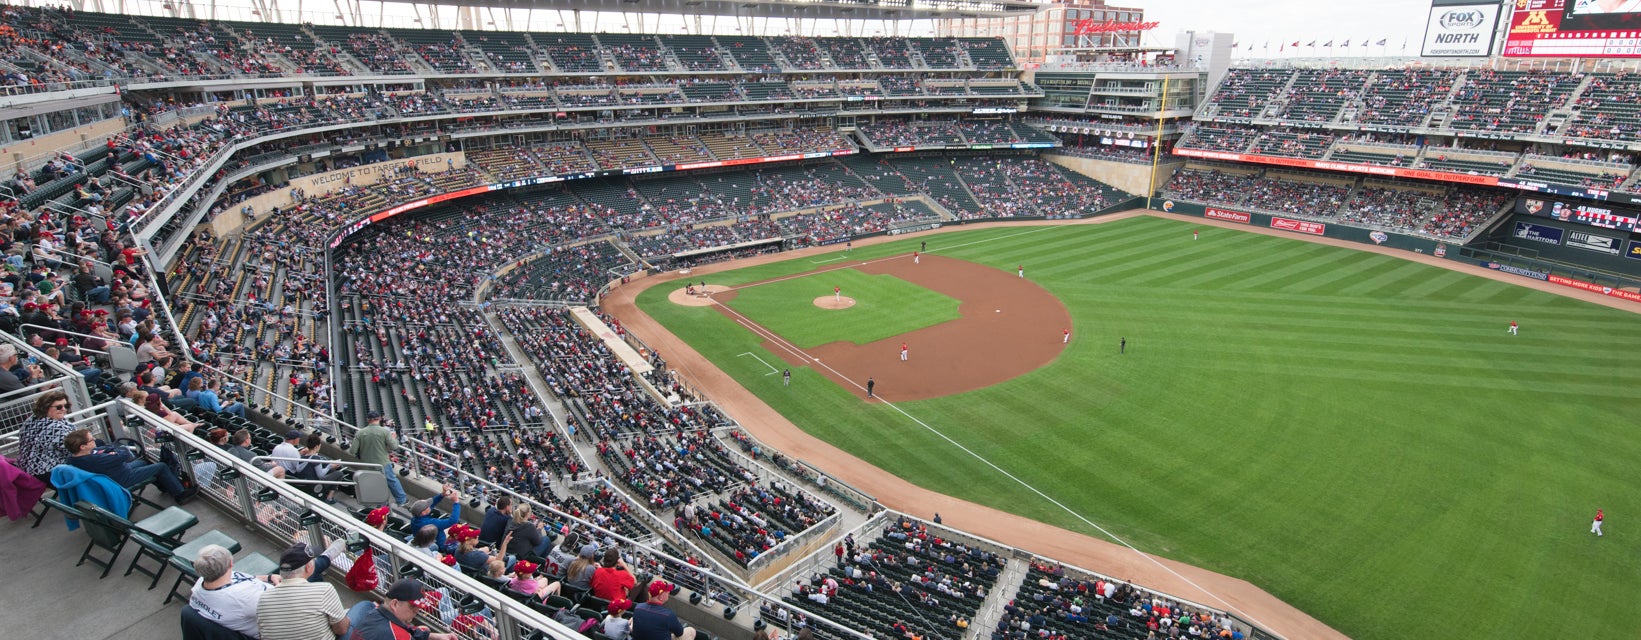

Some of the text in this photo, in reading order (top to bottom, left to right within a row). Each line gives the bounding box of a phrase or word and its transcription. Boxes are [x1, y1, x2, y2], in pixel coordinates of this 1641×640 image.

[1449, 12, 1475, 22] FOX
[1071, 17, 1160, 36] Budweiser
[1435, 33, 1479, 43] NORTH
[311, 170, 355, 186] WELCOME
[372, 162, 407, 173] TARGET
[416, 157, 441, 166] FIELD
[1587, 207, 1611, 215] HUGHES
[1527, 234, 1558, 244] HARTFORD
[1500, 264, 1547, 280] COMMUNITY FUND
[1549, 276, 1572, 285] GETTING
[1573, 281, 1588, 289] MORE
[1588, 284, 1602, 292] KIDS
